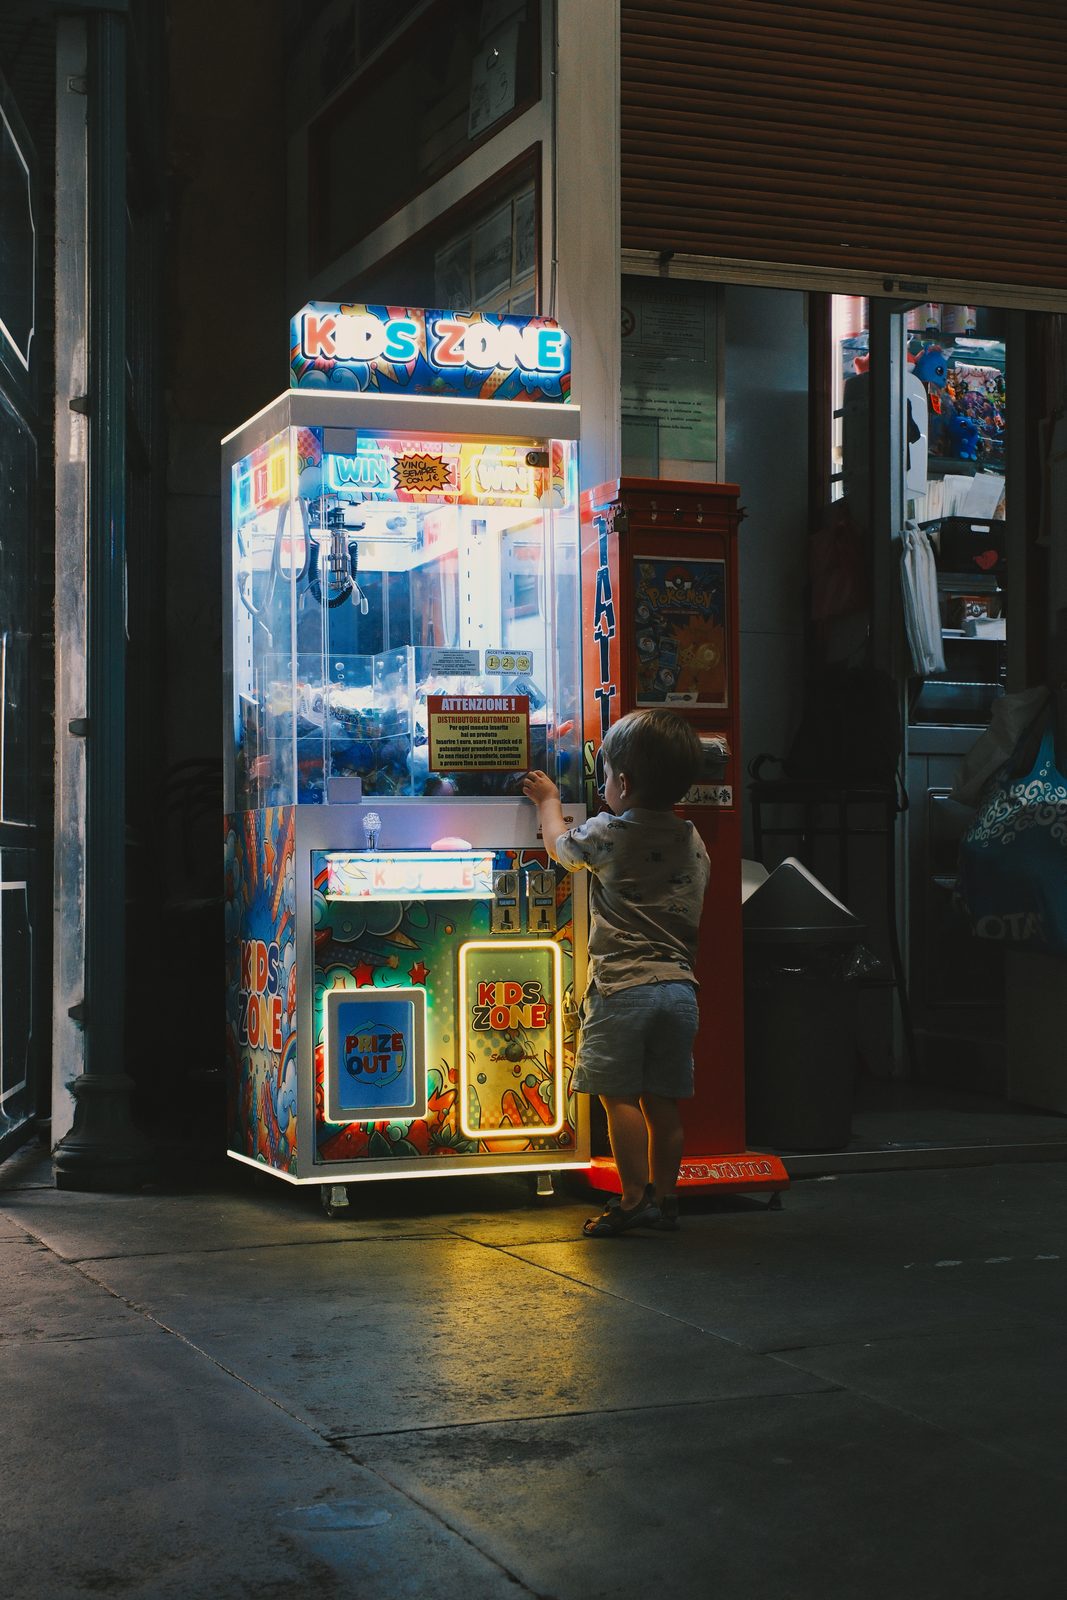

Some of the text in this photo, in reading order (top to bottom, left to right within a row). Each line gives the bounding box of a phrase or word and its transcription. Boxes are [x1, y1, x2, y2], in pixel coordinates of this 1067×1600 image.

[302, 314, 566, 371] KIDS ZONE
[335, 454, 391, 484] WIN
[401, 461, 427, 470] VINCI
[402, 466, 438, 478] SEMPRE
[406, 476, 424, 484] CON
[481, 464, 530, 493] WIN
[441, 698, 509, 711] ATTENZIONE
[437, 716, 520, 724] DISTRIBUTORE AUTOMATICO
[240, 940, 280, 995] KIDS
[477, 981, 542, 1007] KIDS
[238, 994, 283, 1053] ZONE
[472, 1005, 549, 1031] ZONE
[345, 1033, 403, 1054] PRIZE
[346, 1053, 390, 1075] OUT
